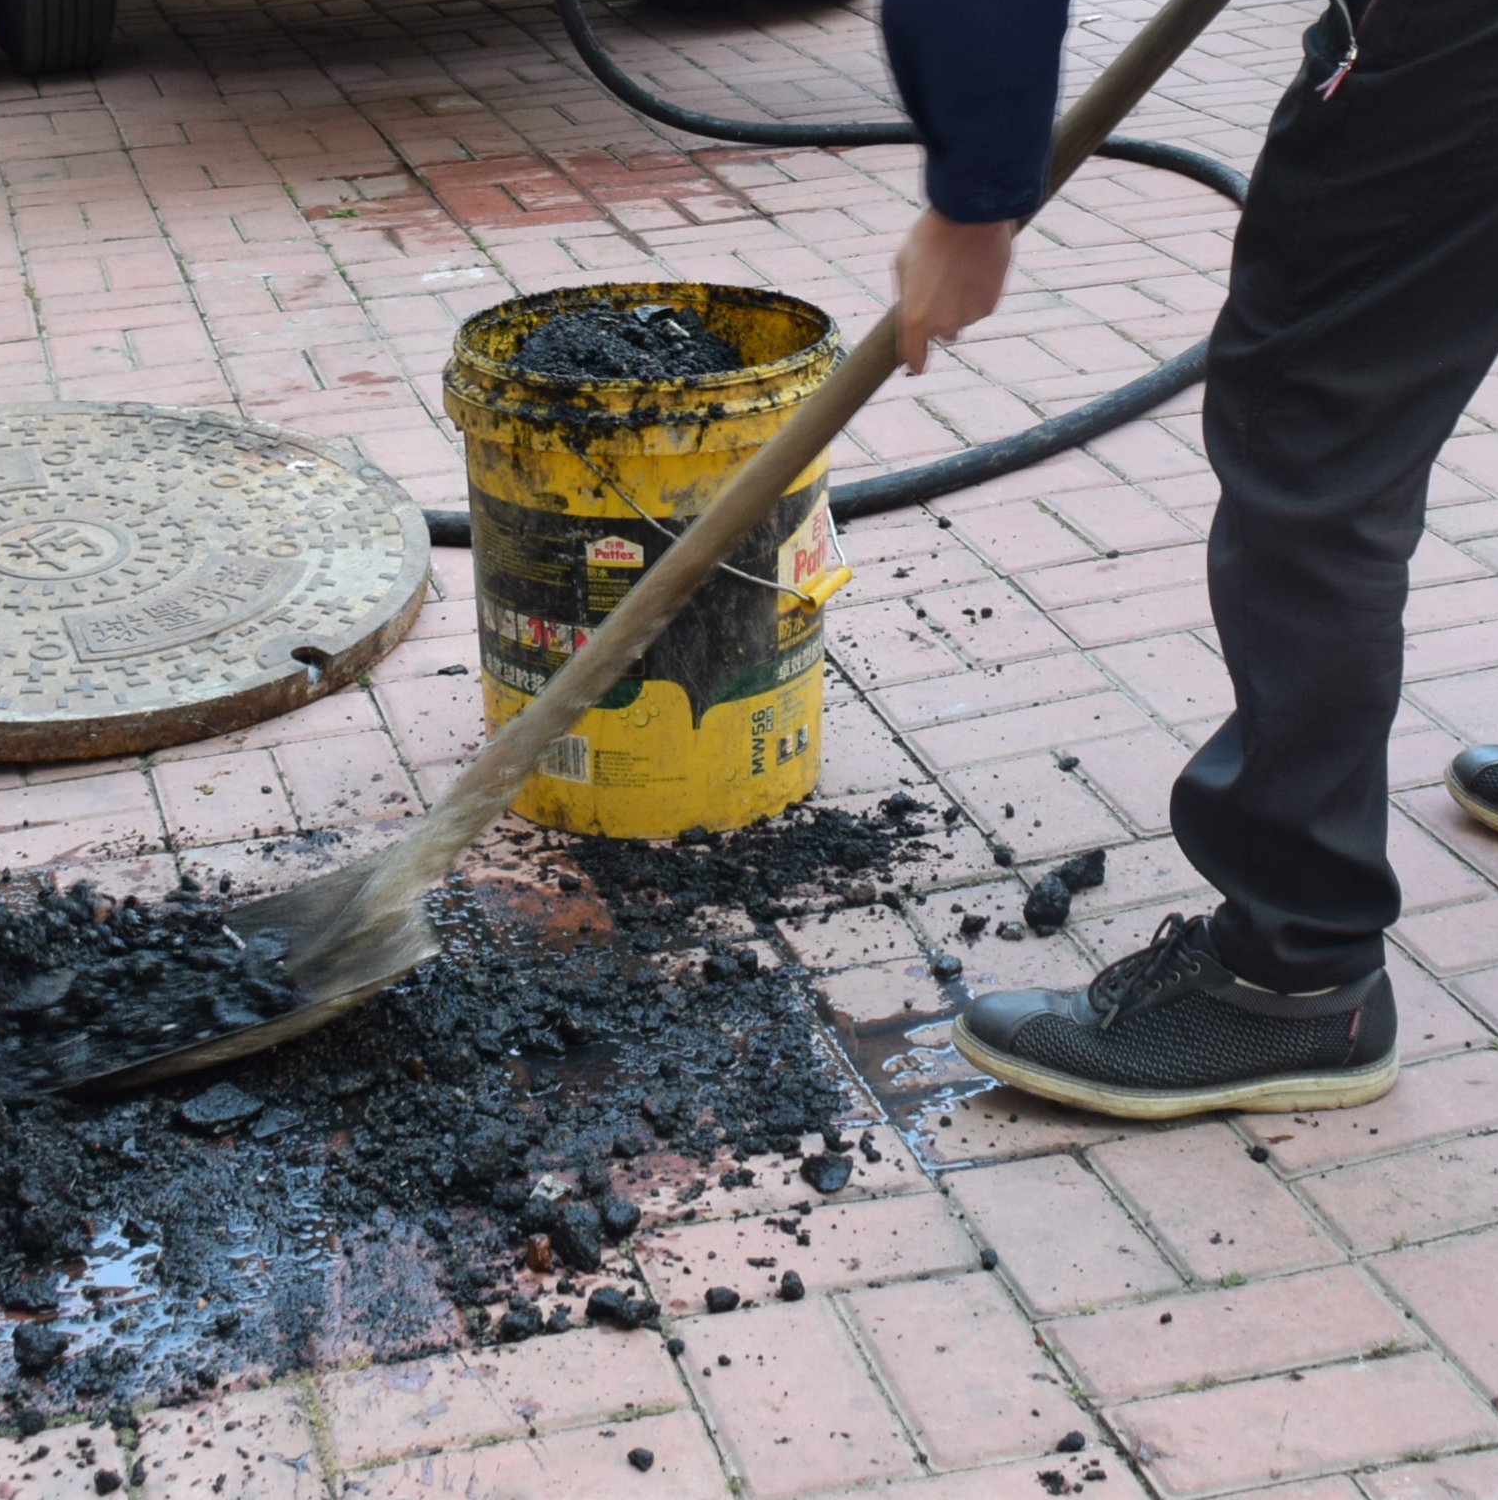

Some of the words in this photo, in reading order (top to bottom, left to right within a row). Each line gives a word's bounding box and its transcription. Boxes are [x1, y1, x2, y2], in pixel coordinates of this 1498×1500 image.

[594, 548, 636, 561] Pattex
[778, 612, 806, 642] 防水
[751, 708, 766, 777] MW56
